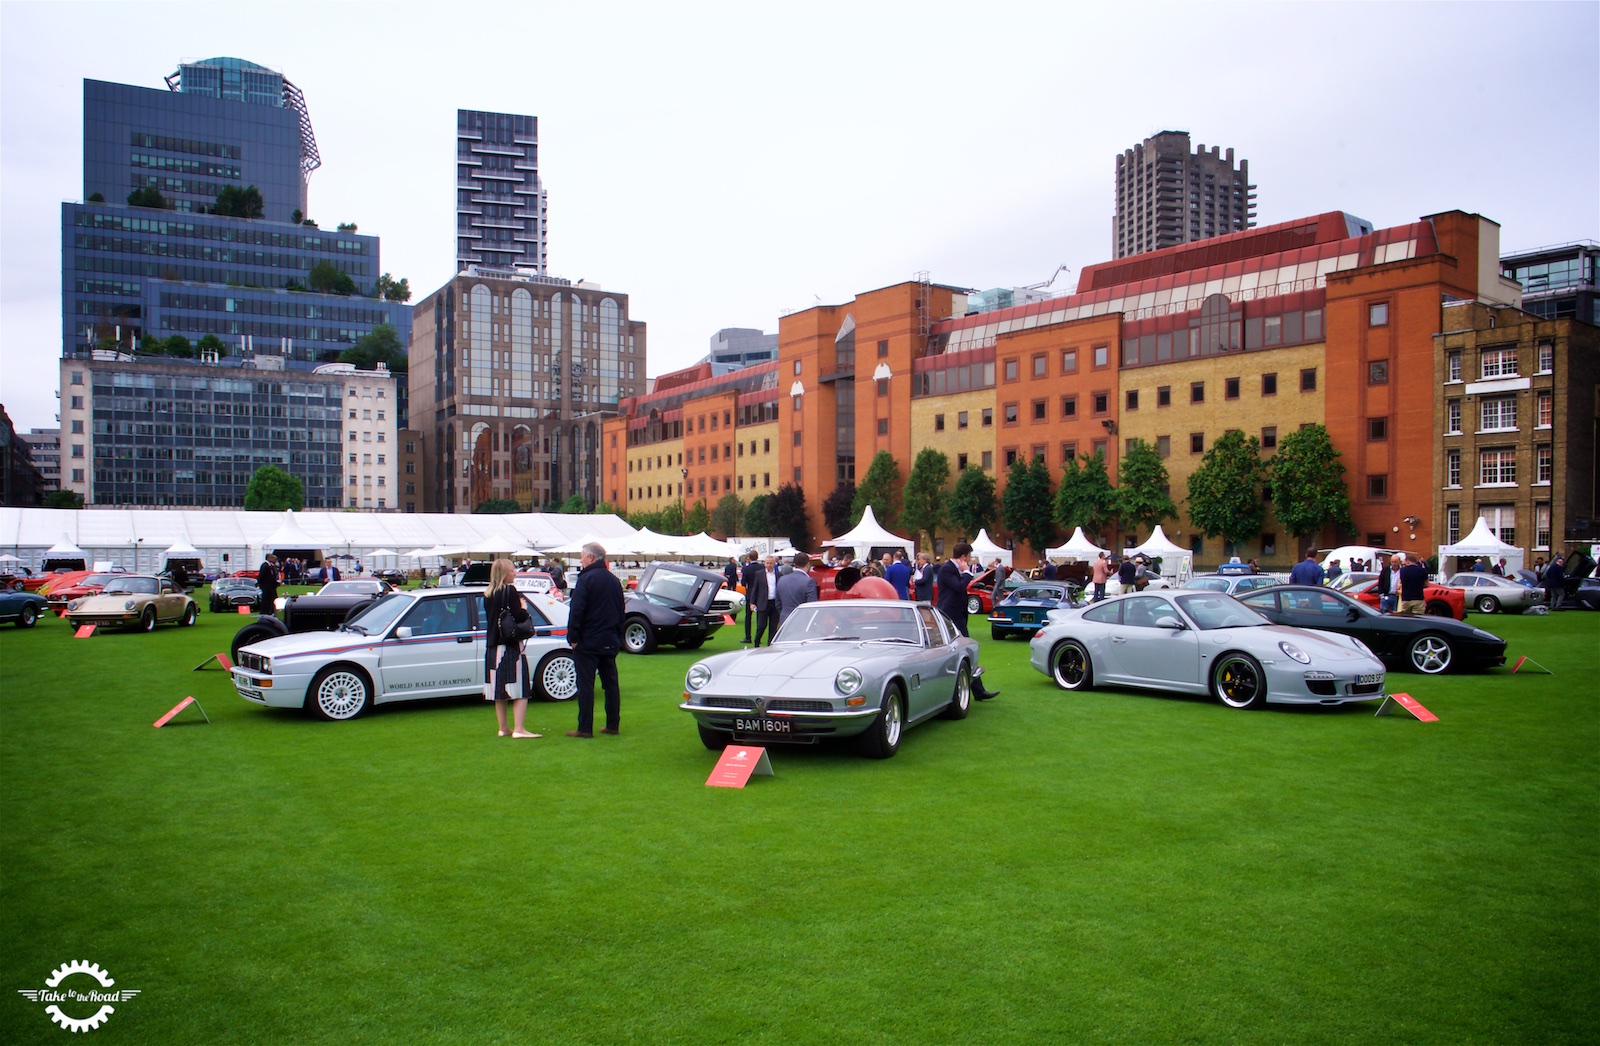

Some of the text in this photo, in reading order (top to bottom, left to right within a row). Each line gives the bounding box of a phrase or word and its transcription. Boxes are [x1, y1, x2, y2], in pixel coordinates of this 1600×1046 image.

[527, 579, 547, 588] RACING
[439, 677, 472, 686] CHAMPION
[736, 718, 790, 733] BAM 160H
